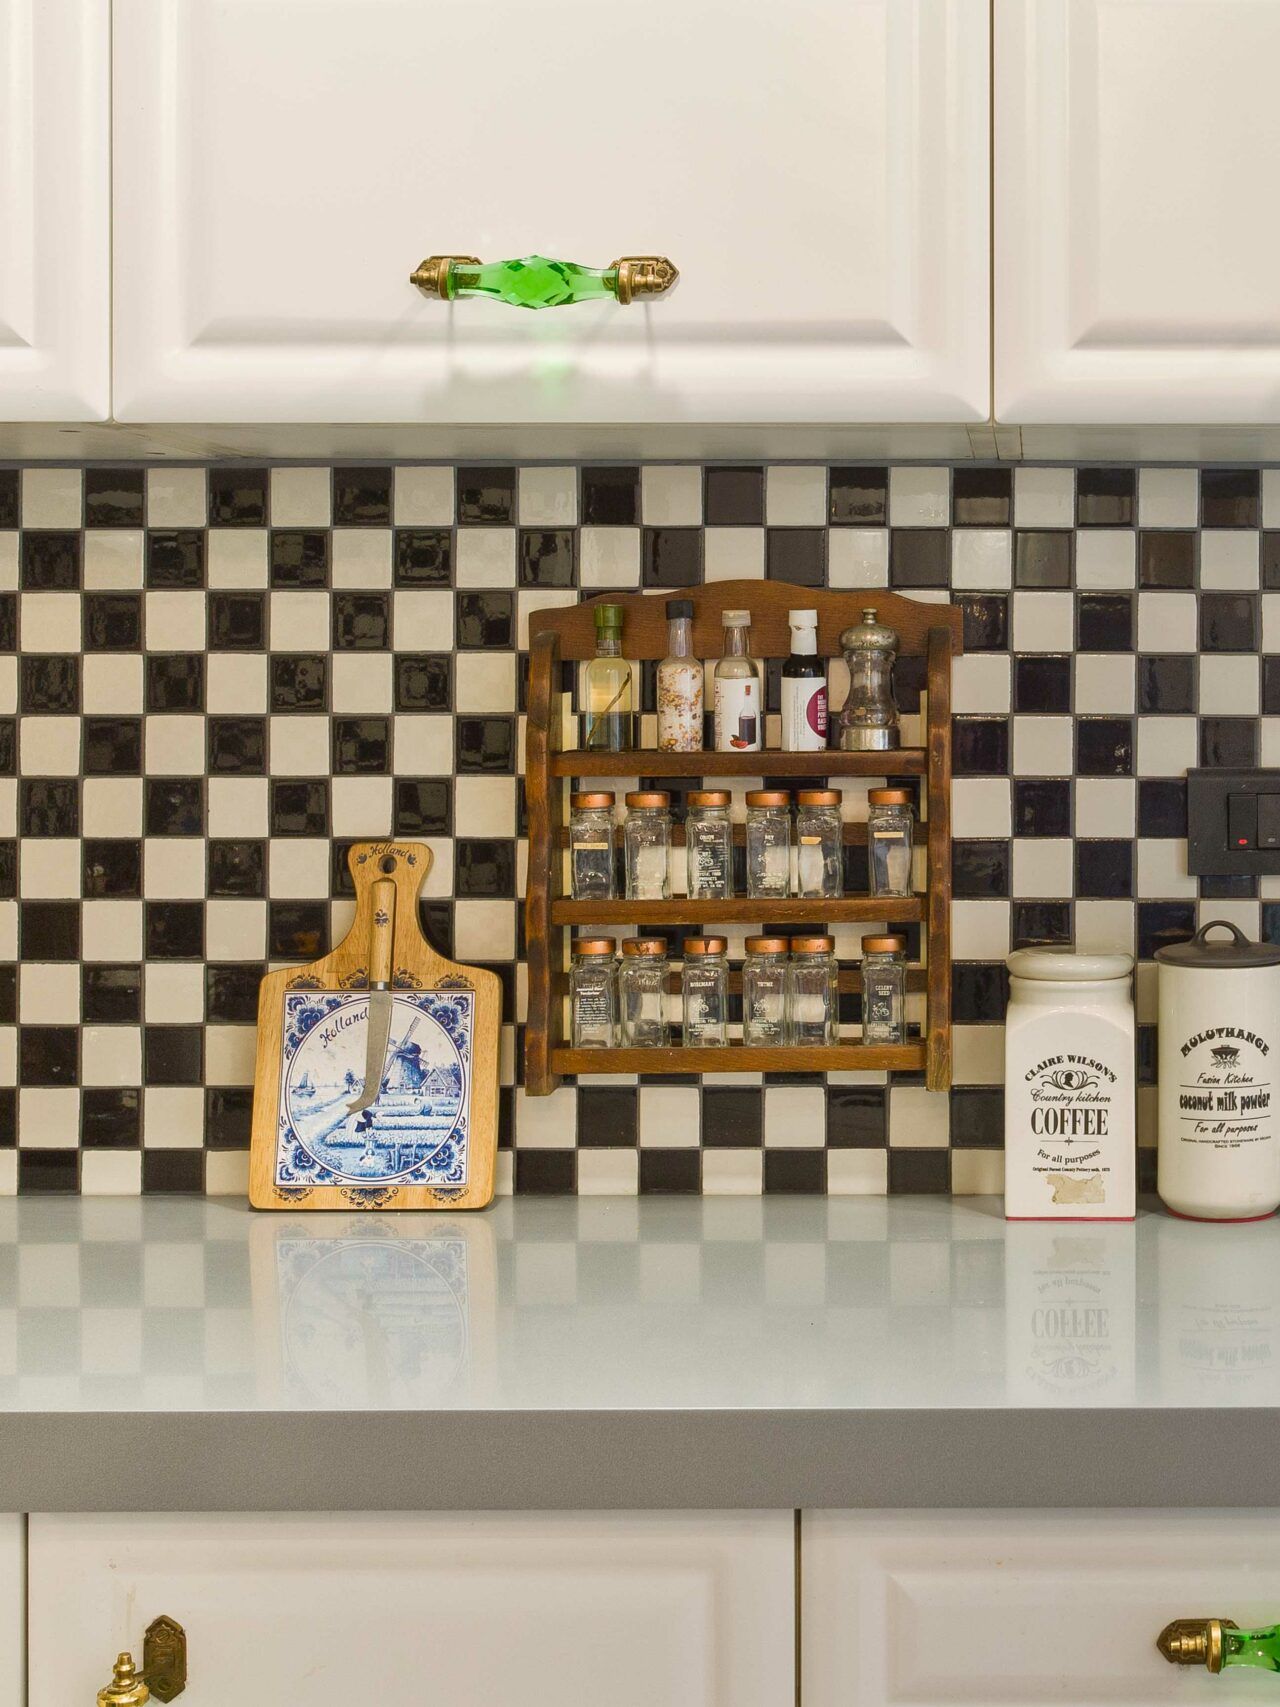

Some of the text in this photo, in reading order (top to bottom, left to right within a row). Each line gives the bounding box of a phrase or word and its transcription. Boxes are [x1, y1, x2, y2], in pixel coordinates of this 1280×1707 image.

[369, 843, 409, 858] Holland
[319, 1006, 370, 1049] Holland
[1180, 1027, 1270, 1058] MULUTHANGE
[1025, 1054, 1118, 1083] CLAIRE WILSON'S
[1197, 1072, 1254, 1085] Fusion Kitchen
[1030, 1088, 1112, 1107] Country kitchen
[1179, 1088, 1271, 1116] coconut milk powder
[1031, 1108, 1109, 1135] COFFEE
[1194, 1121, 1209, 1133] For
[1211, 1122, 1226, 1133] all
[1224, 1124, 1259, 1138] purposes
[1037, 1149, 1101, 1165] For all purposes
